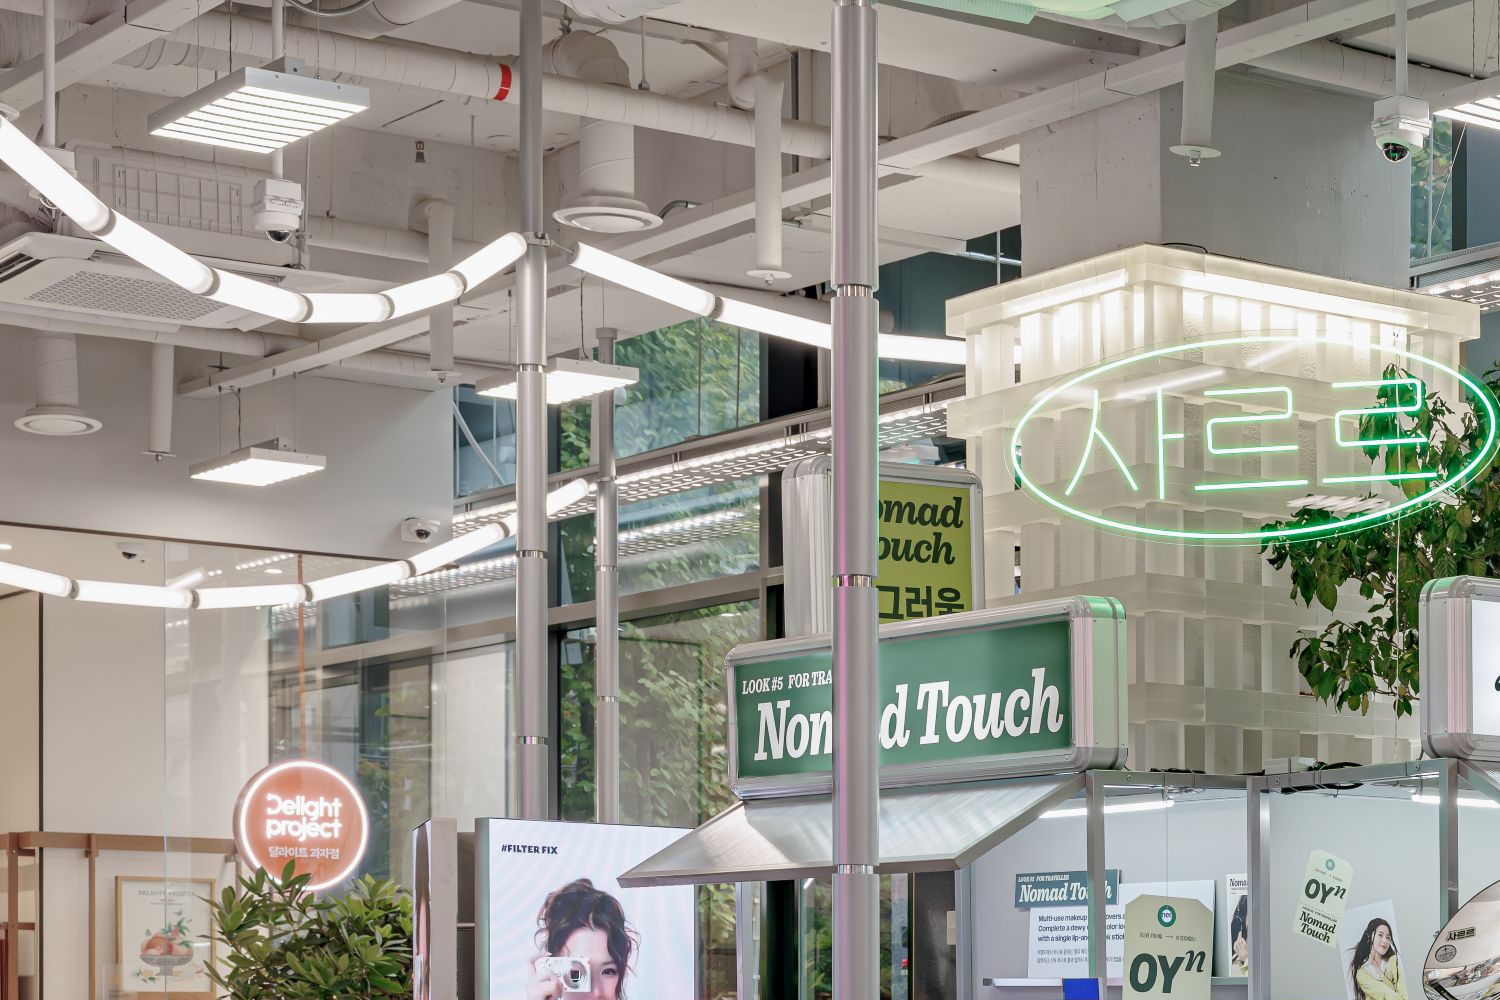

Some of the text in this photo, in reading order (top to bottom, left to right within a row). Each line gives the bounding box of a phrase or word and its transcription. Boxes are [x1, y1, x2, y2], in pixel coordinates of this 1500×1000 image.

[1065, 378, 1438, 500] 사르르
[879, 532, 955, 565] ouch
[742, 677, 770, 695] LOOK
[771, 676, 783, 692] #5
[788, 673, 809, 689] FOR
[917, 668, 1063, 745] Touch
[266, 793, 343, 822] Delight
[266, 817, 343, 842] project
[501, 844, 558, 855] #FILTER FIX
[1019, 882, 1068, 902] Nomad
[1065, 915, 1088, 923] makeup
[1299, 911, 1337, 934] Nomad
[1055, 935, 1071, 943] single
[1300, 923, 1330, 943] Touch
